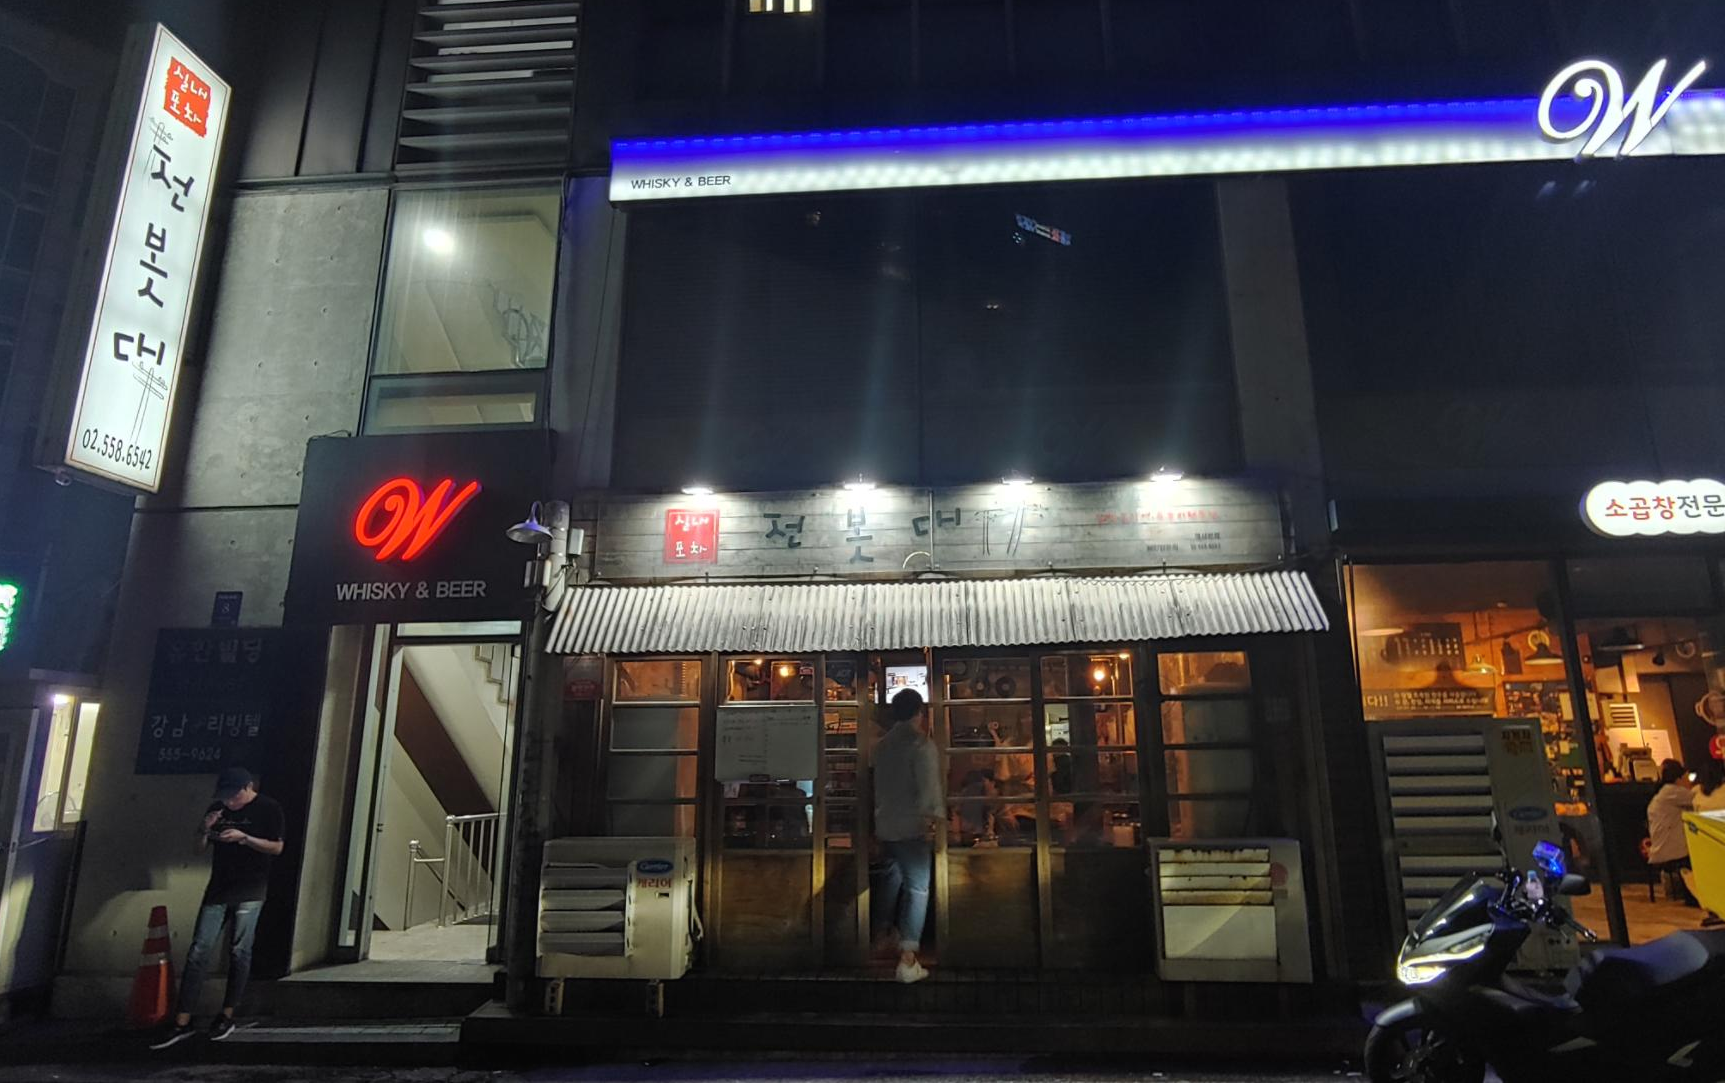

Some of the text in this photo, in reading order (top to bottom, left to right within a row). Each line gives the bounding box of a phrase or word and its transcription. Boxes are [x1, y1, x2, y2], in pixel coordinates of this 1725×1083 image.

[173, 65, 208, 100] 실내
[169, 89, 202, 123] 포차
[630, 175, 731, 189] WHISKY & BEER
[82, 428, 153, 471] 02.558.6542
[1605, 495, 1725, 521] 소곱창전문
[675, 514, 709, 531] 실내
[675, 541, 708, 557] 포차
[337, 580, 487, 600] WHISKY & BEER
[151, 713, 188, 738] 강남
